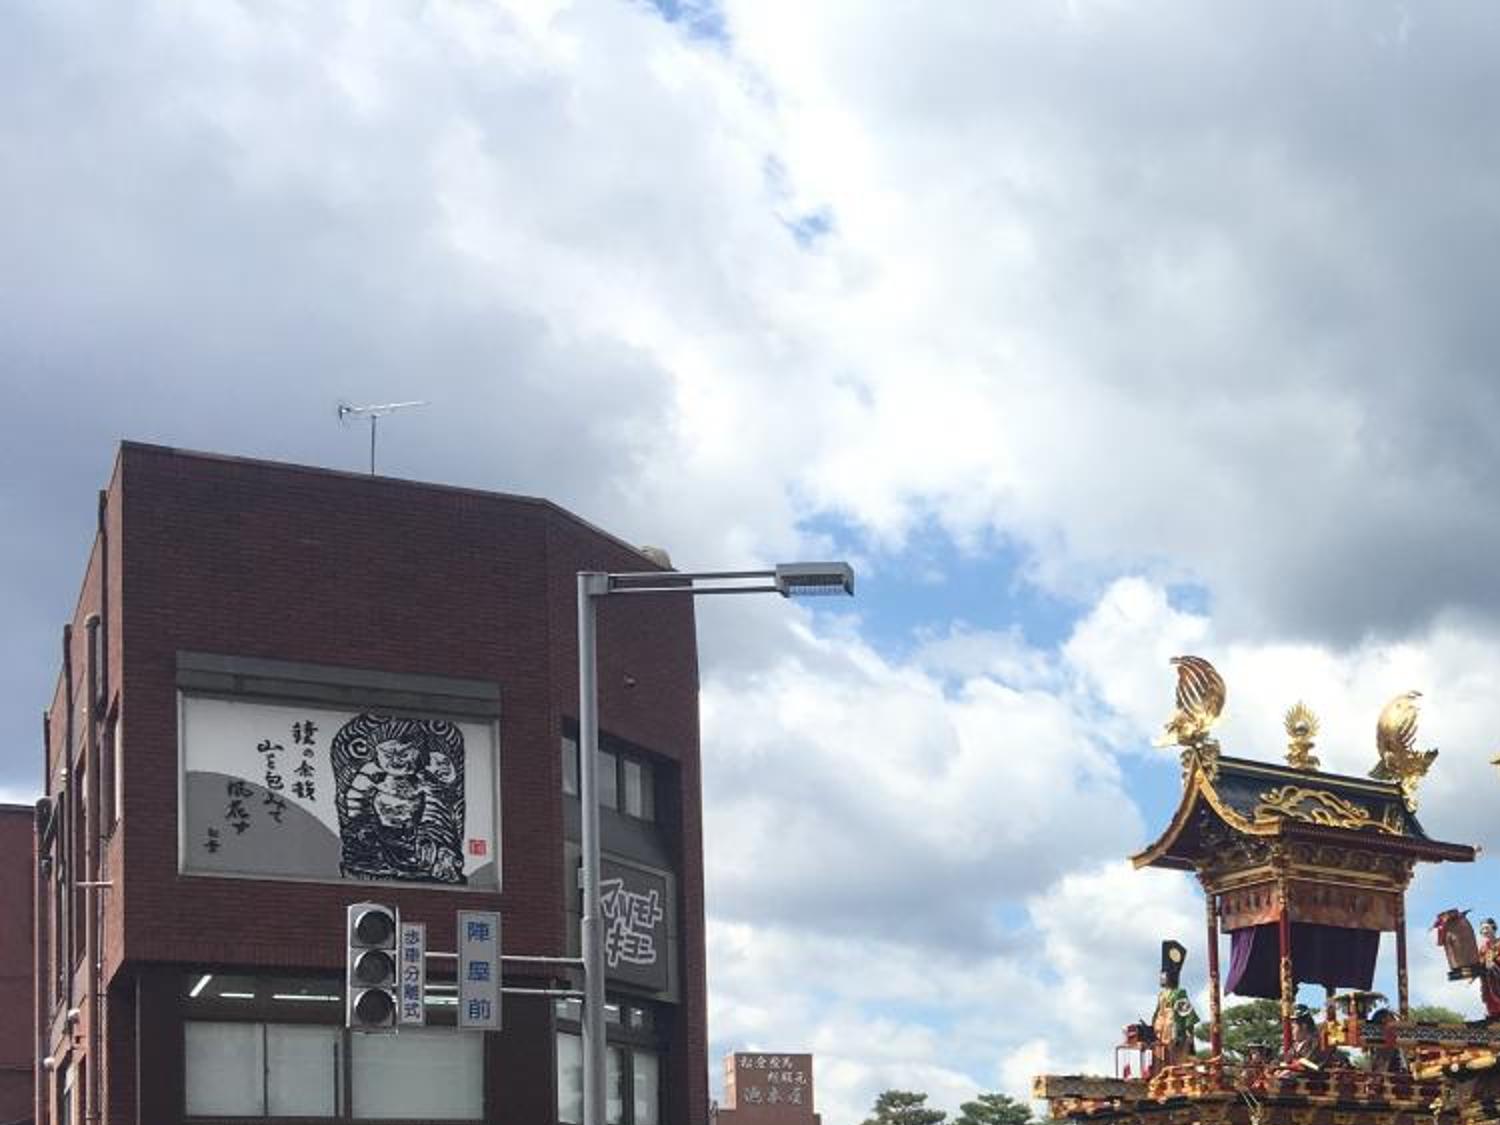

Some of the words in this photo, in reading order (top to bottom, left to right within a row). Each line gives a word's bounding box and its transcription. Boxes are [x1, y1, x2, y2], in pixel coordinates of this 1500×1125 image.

[599, 877, 663, 935] マツモト
[605, 917, 657, 967] キヨシ
[403, 929, 421, 1019] 歩車分離式
[467, 920, 493, 1020] 陣屋前
